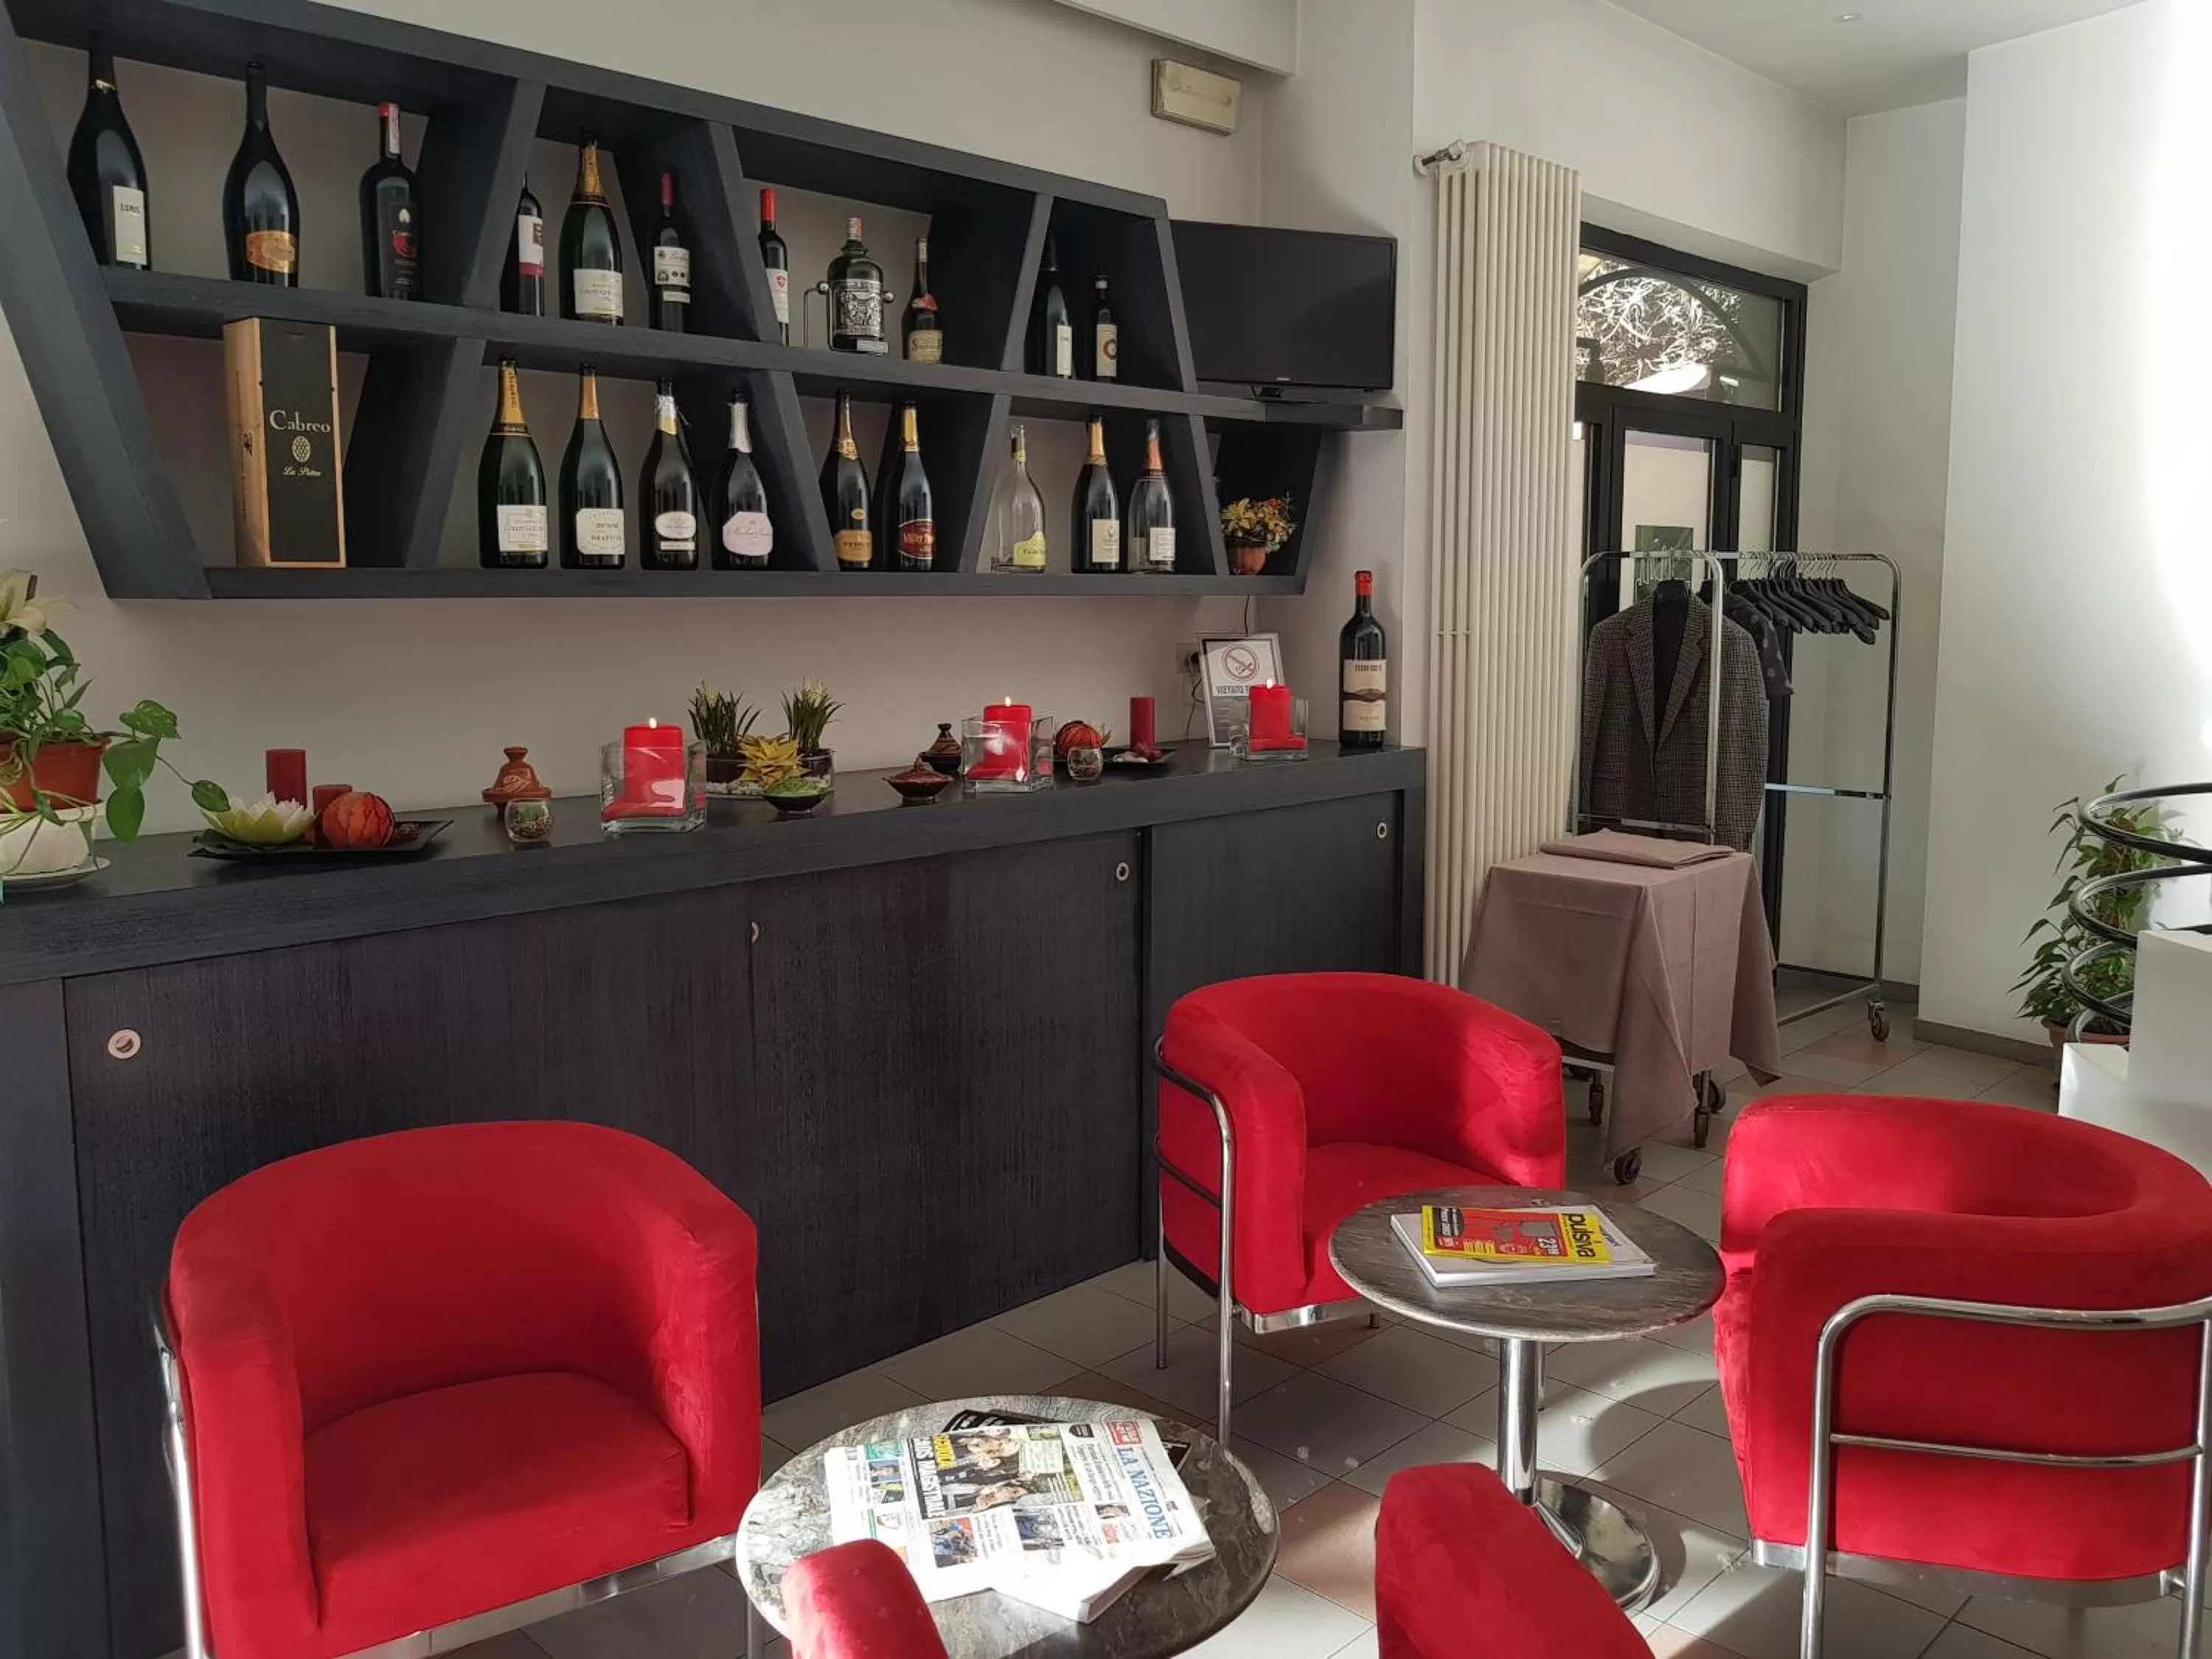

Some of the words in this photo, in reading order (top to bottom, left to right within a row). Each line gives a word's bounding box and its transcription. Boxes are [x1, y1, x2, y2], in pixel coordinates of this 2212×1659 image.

[269, 409, 331, 434] Cabreo
[1216, 684, 1244, 694] VIETATO
[1117, 1447, 1138, 1466] LA
[1127, 1469, 1175, 1539] NAZIONE
